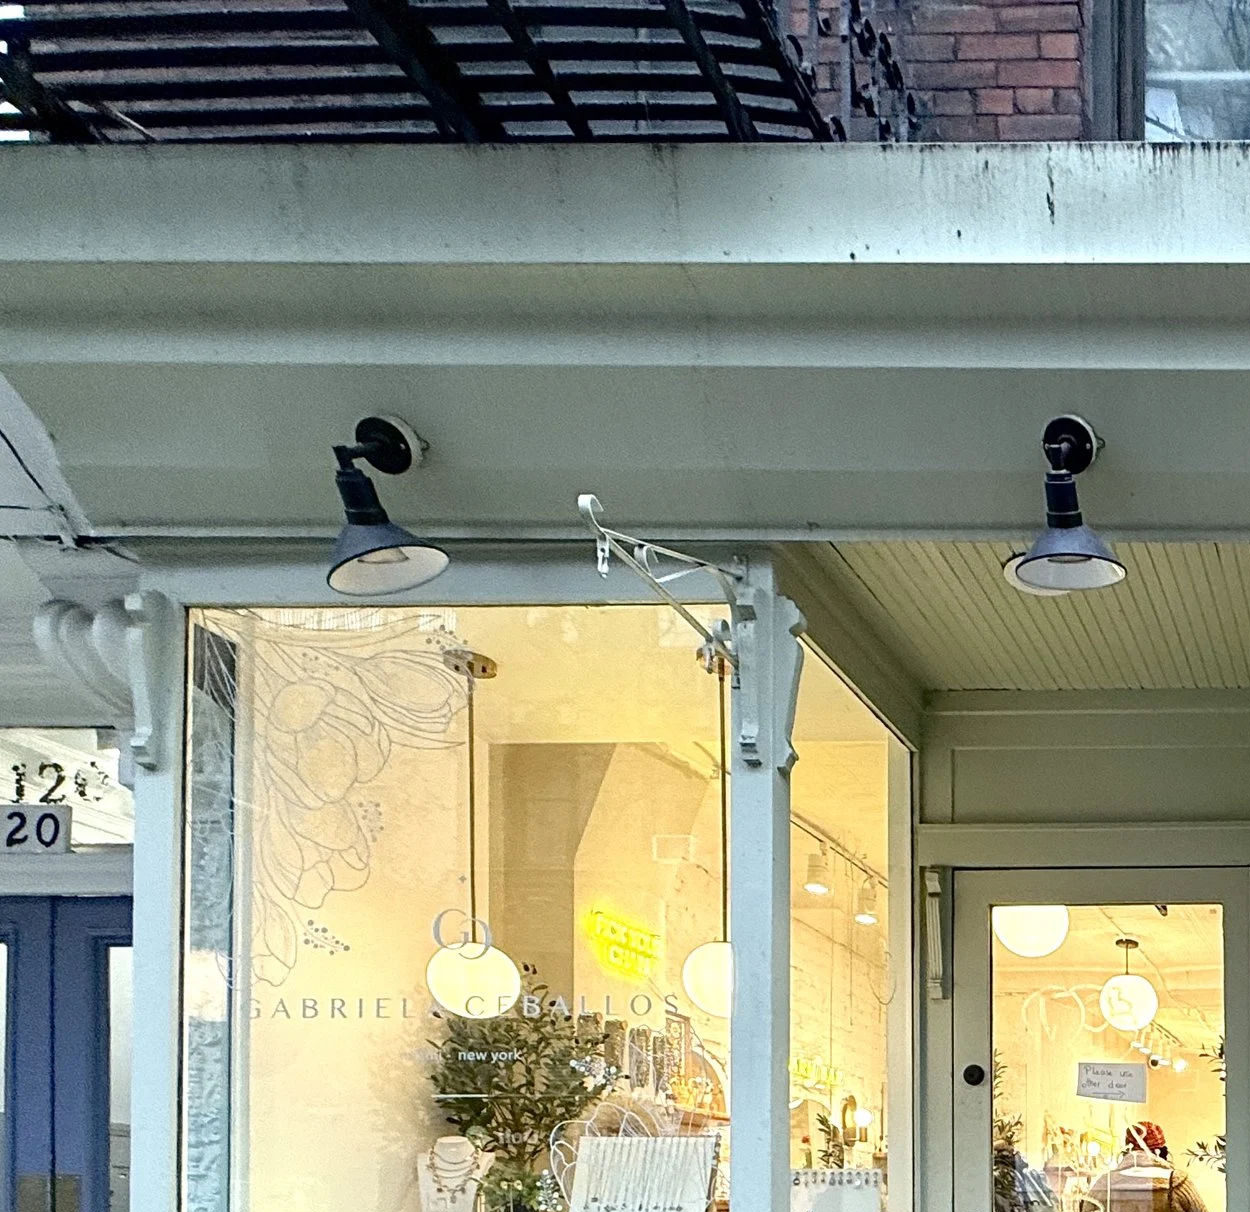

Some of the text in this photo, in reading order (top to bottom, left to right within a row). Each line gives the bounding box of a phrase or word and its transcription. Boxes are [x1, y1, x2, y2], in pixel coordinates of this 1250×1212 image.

[250, 993, 679, 1019] GABRIEL CEBALLOS
[457, 1049, 487, 1061] new
[490, 1047, 522, 1064] york
